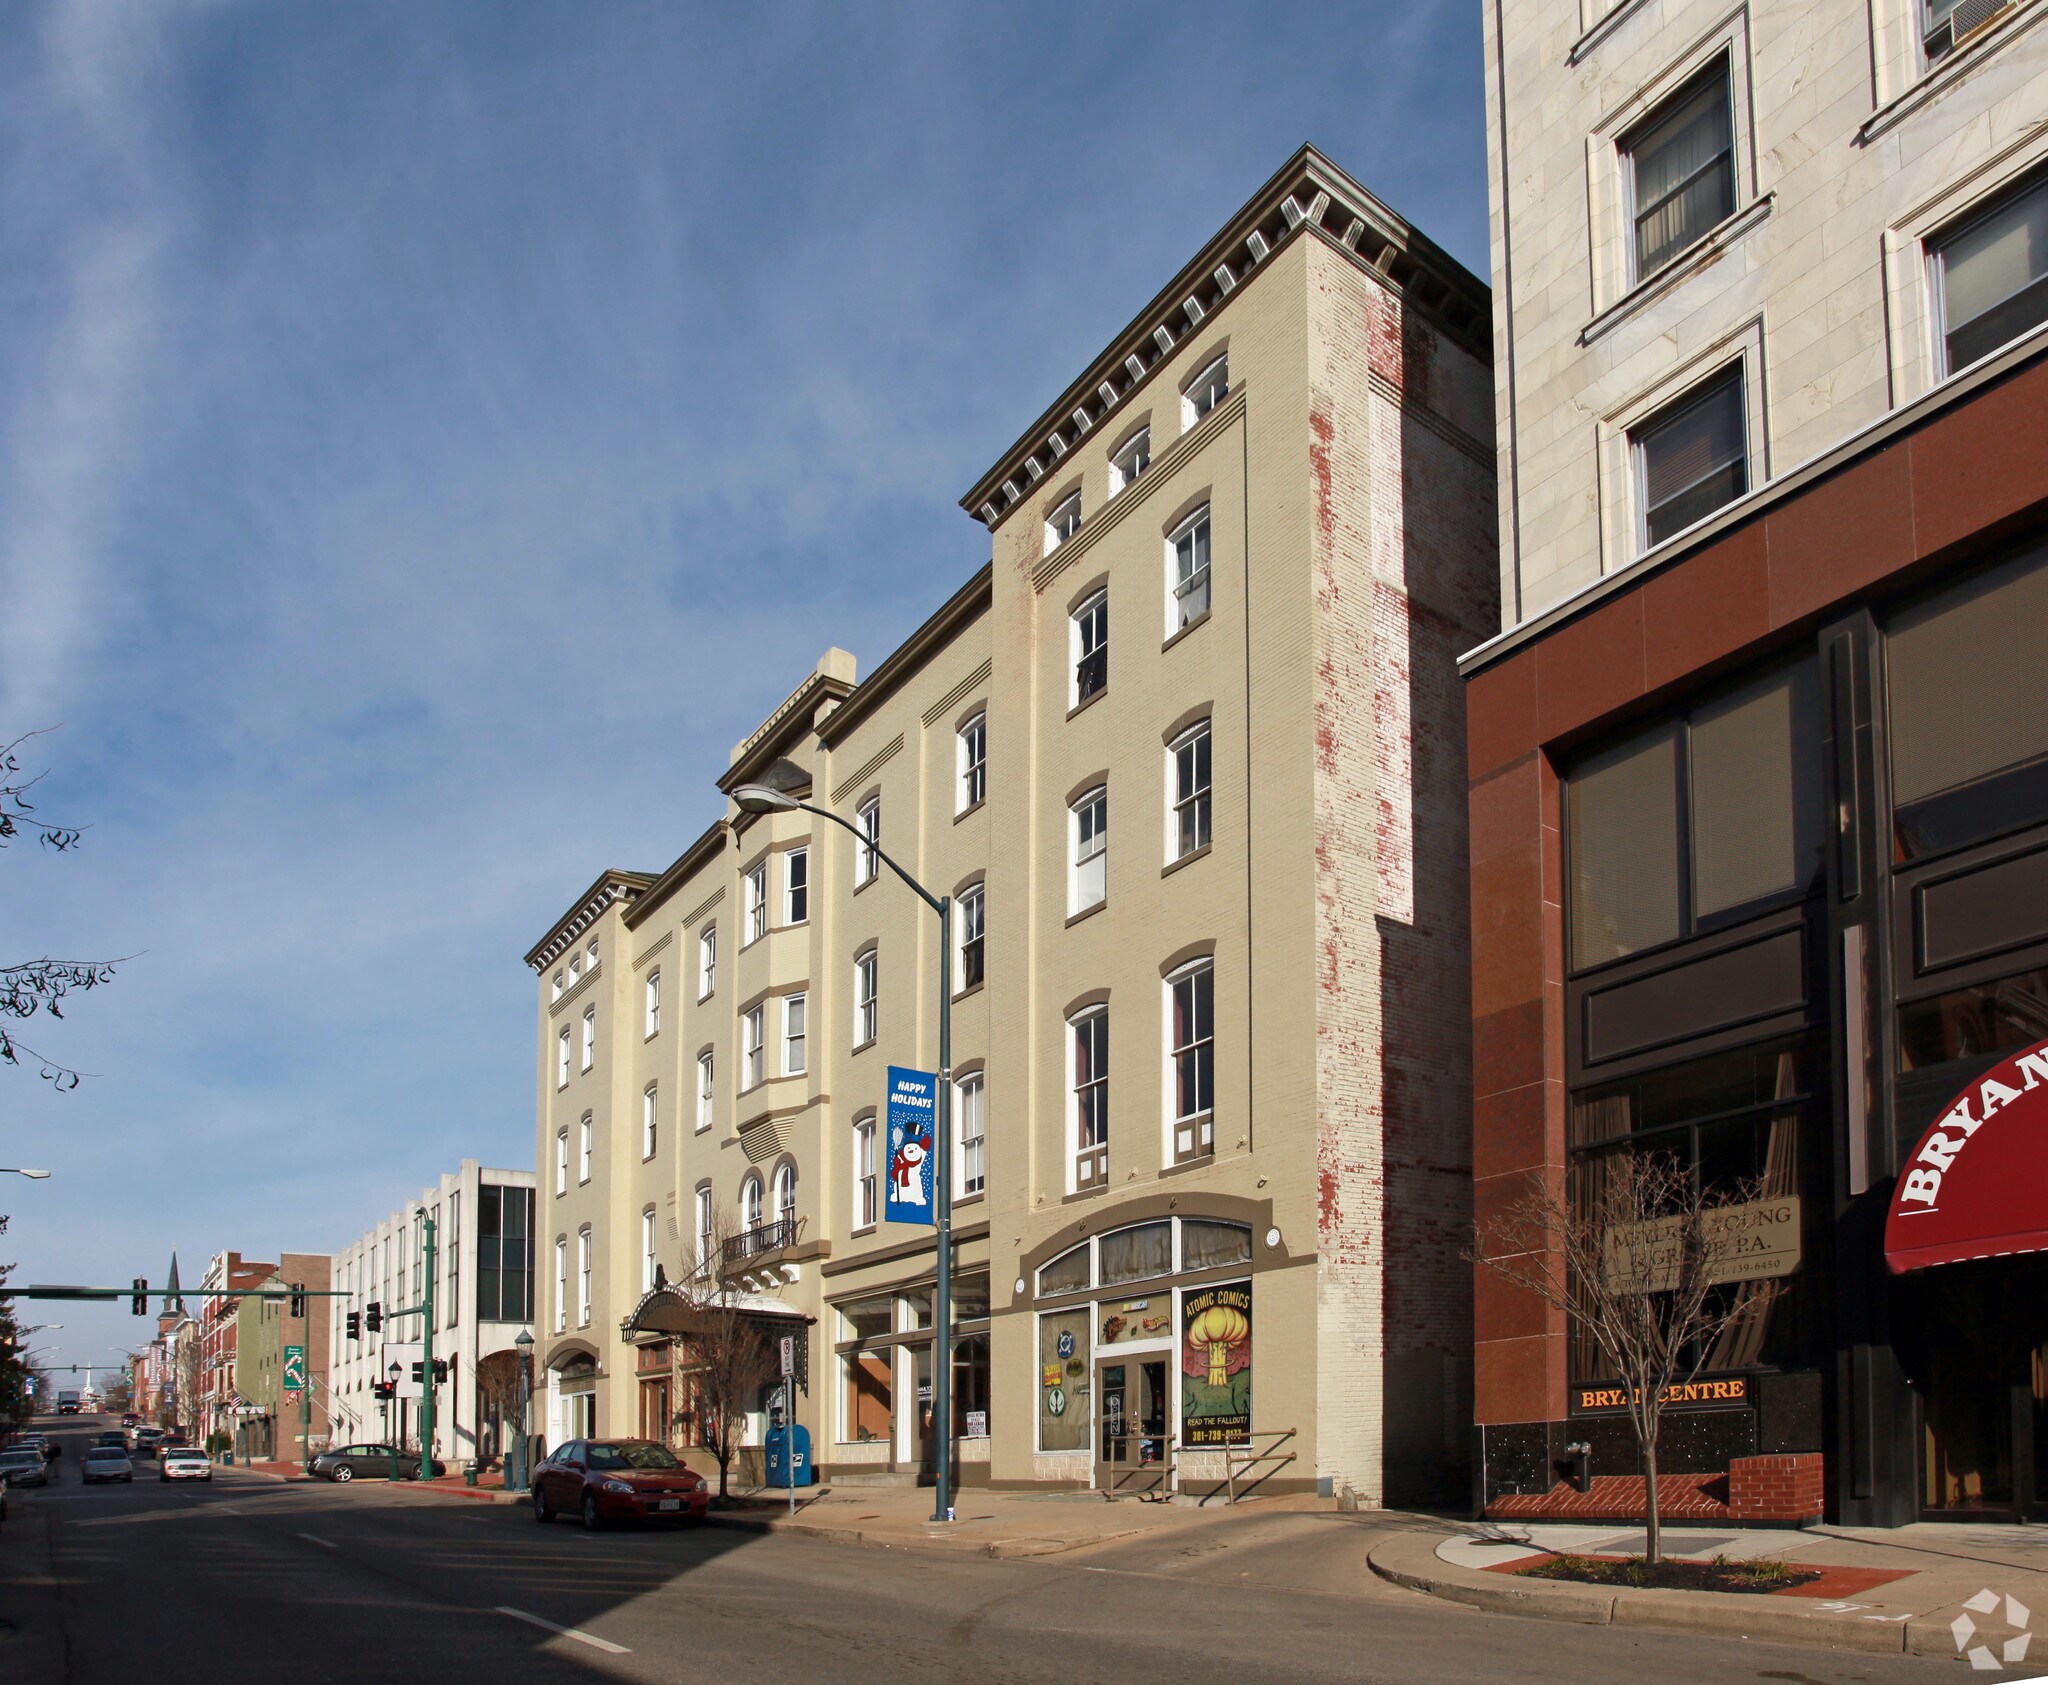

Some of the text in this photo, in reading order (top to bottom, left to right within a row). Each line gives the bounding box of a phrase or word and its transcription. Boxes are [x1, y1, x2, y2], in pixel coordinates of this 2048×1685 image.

[897, 1080, 927, 1095] HAPPY
[890, 1092, 933, 1109] HOLIDAYS
[1900, 1046, 2048, 1206] BRYAN
[1736, 1234, 1772, 1253] P.A.
[1185, 1290, 1250, 1318] ATOMIC COMICS
[1187, 1415, 1248, 1427] READ THE FALLOUT!
